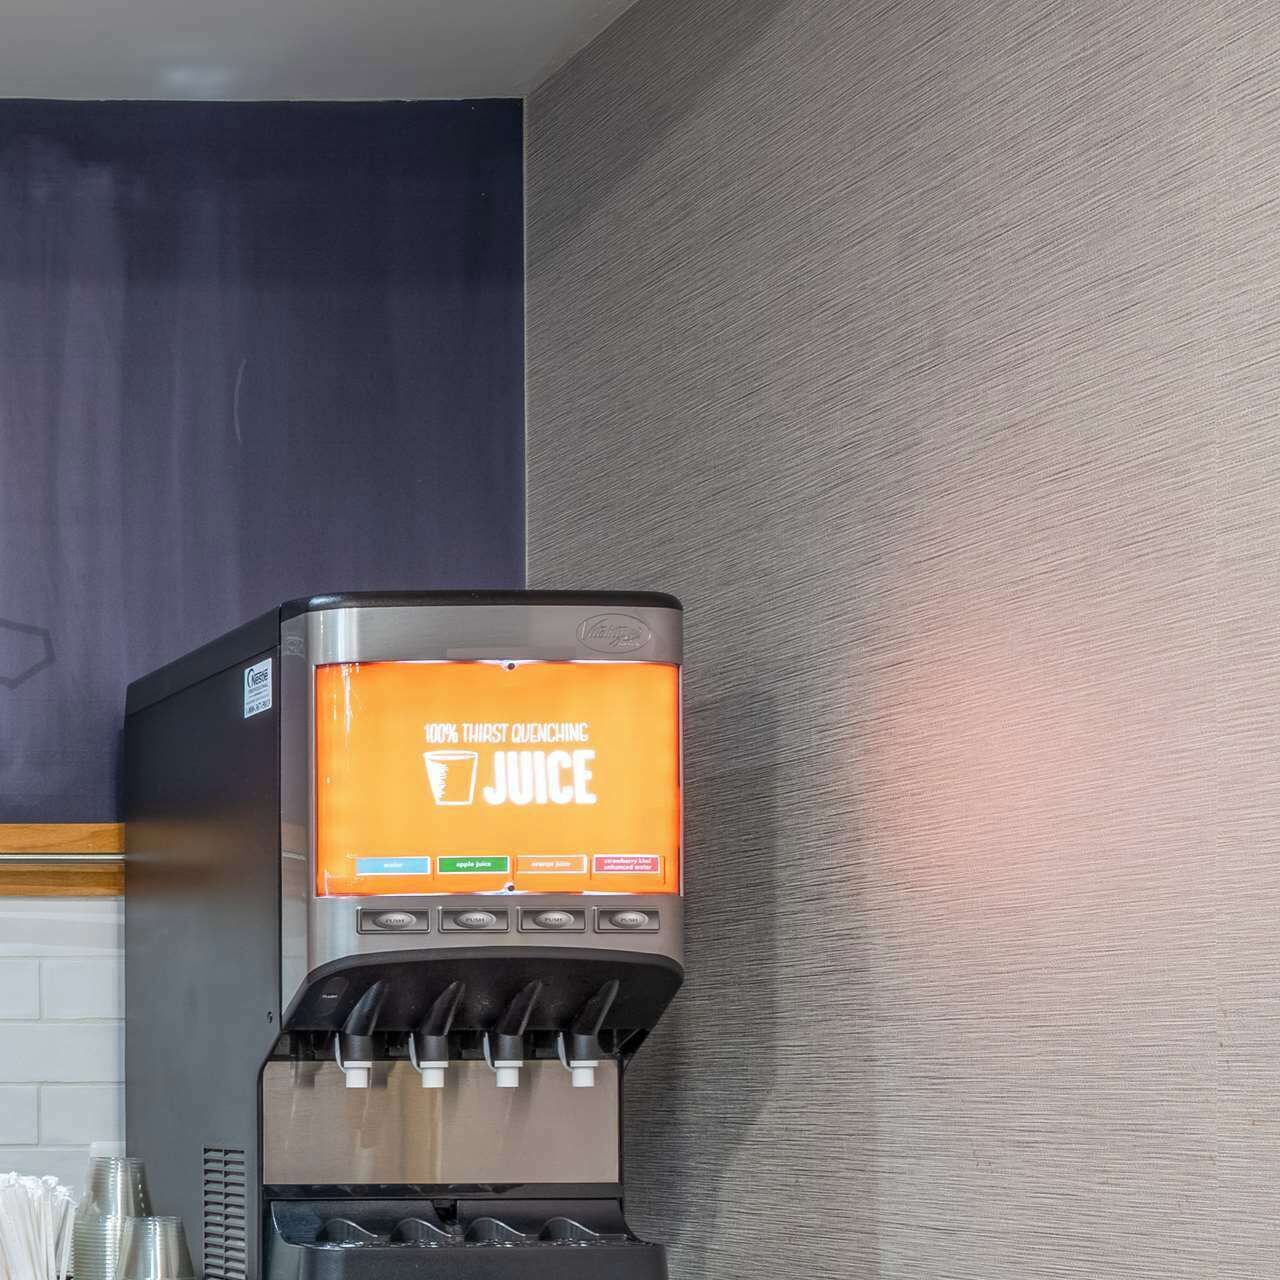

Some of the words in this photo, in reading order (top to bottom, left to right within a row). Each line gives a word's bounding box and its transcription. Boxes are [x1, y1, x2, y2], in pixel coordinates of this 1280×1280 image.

[423, 722, 459, 744] 100%
[461, 722, 510, 744] THIRST
[511, 721, 590, 743] QUENCHING
[482, 748, 598, 806] JUICE
[455, 861, 474, 869] apple
[475, 860, 492, 869] juice
